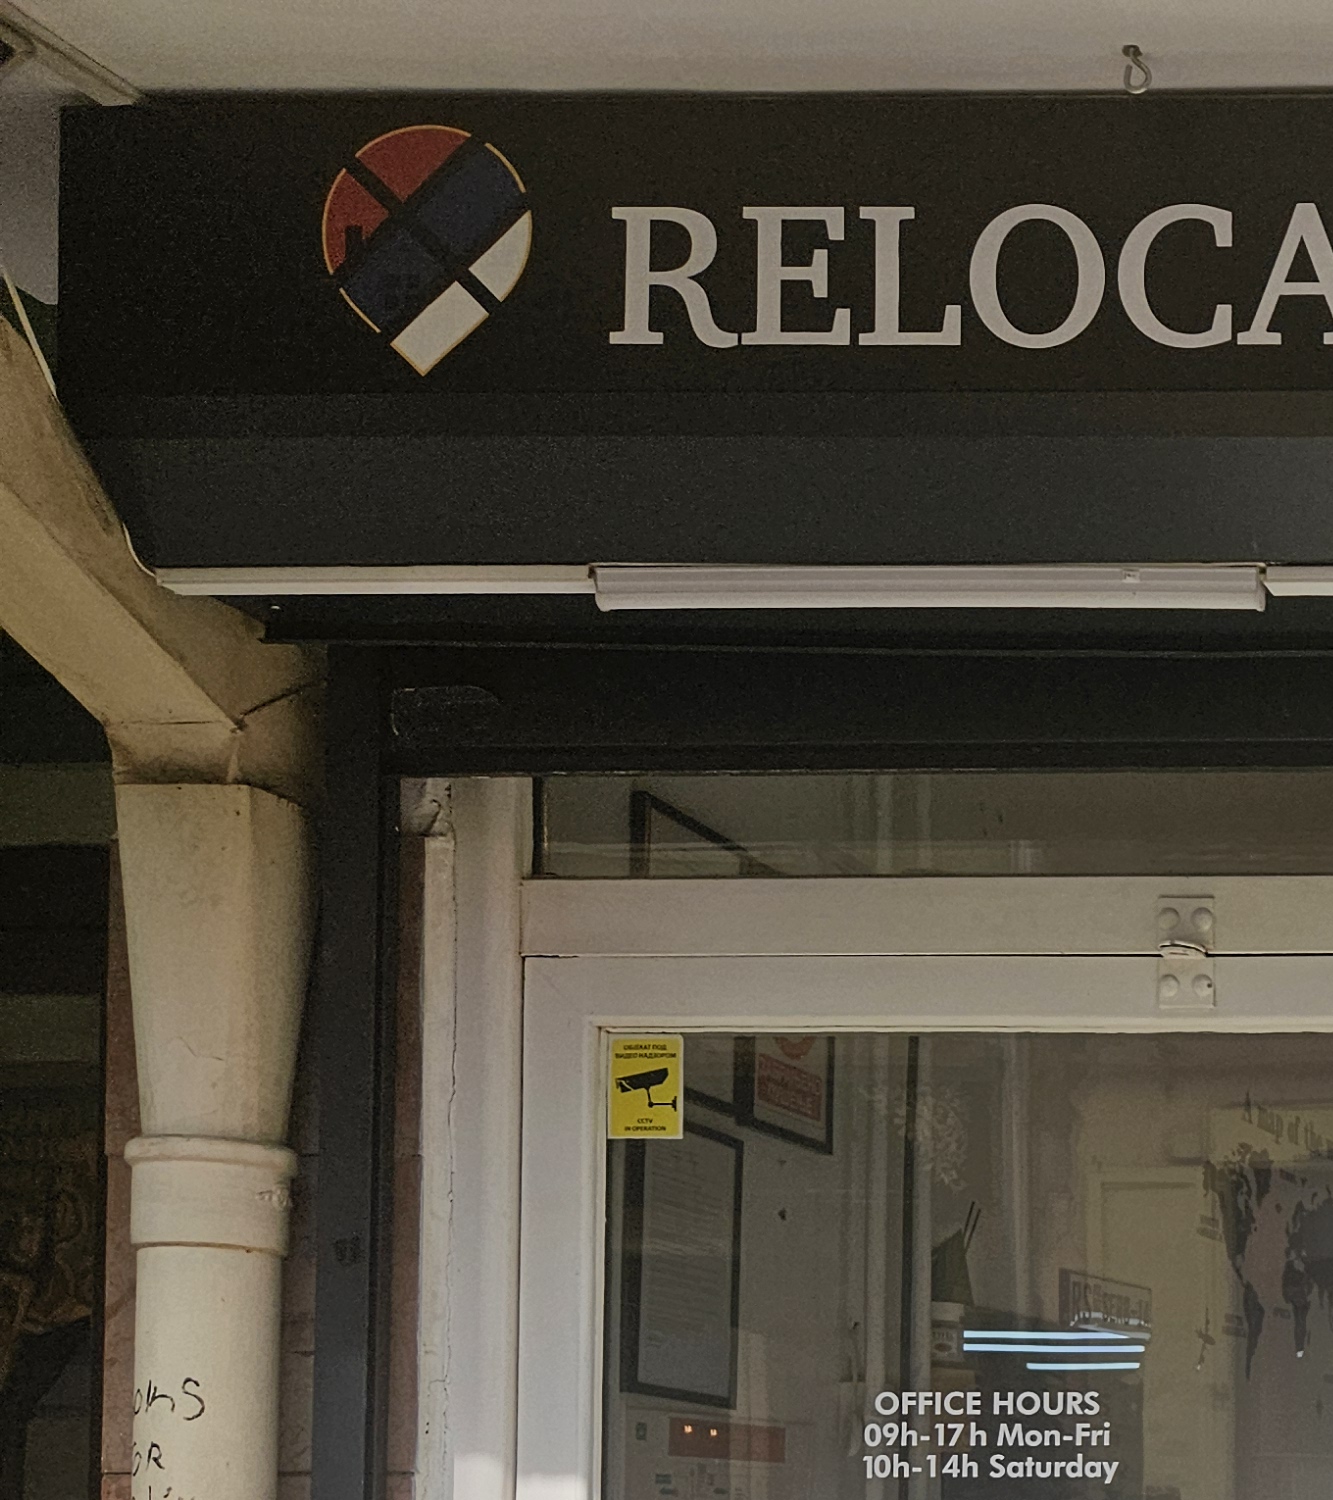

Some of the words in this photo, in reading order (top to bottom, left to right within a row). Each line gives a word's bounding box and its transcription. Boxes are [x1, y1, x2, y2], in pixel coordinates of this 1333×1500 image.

[874, 1391, 982, 1416] OFFICE
[993, 1391, 1100, 1416] HOURS
[864, 1421, 987, 1447] 09h-17h
[996, 1421, 1111, 1447] Mon-Fri
[862, 1453, 979, 1479] 10h-14h
[989, 1452, 1120, 1485] Saturday
